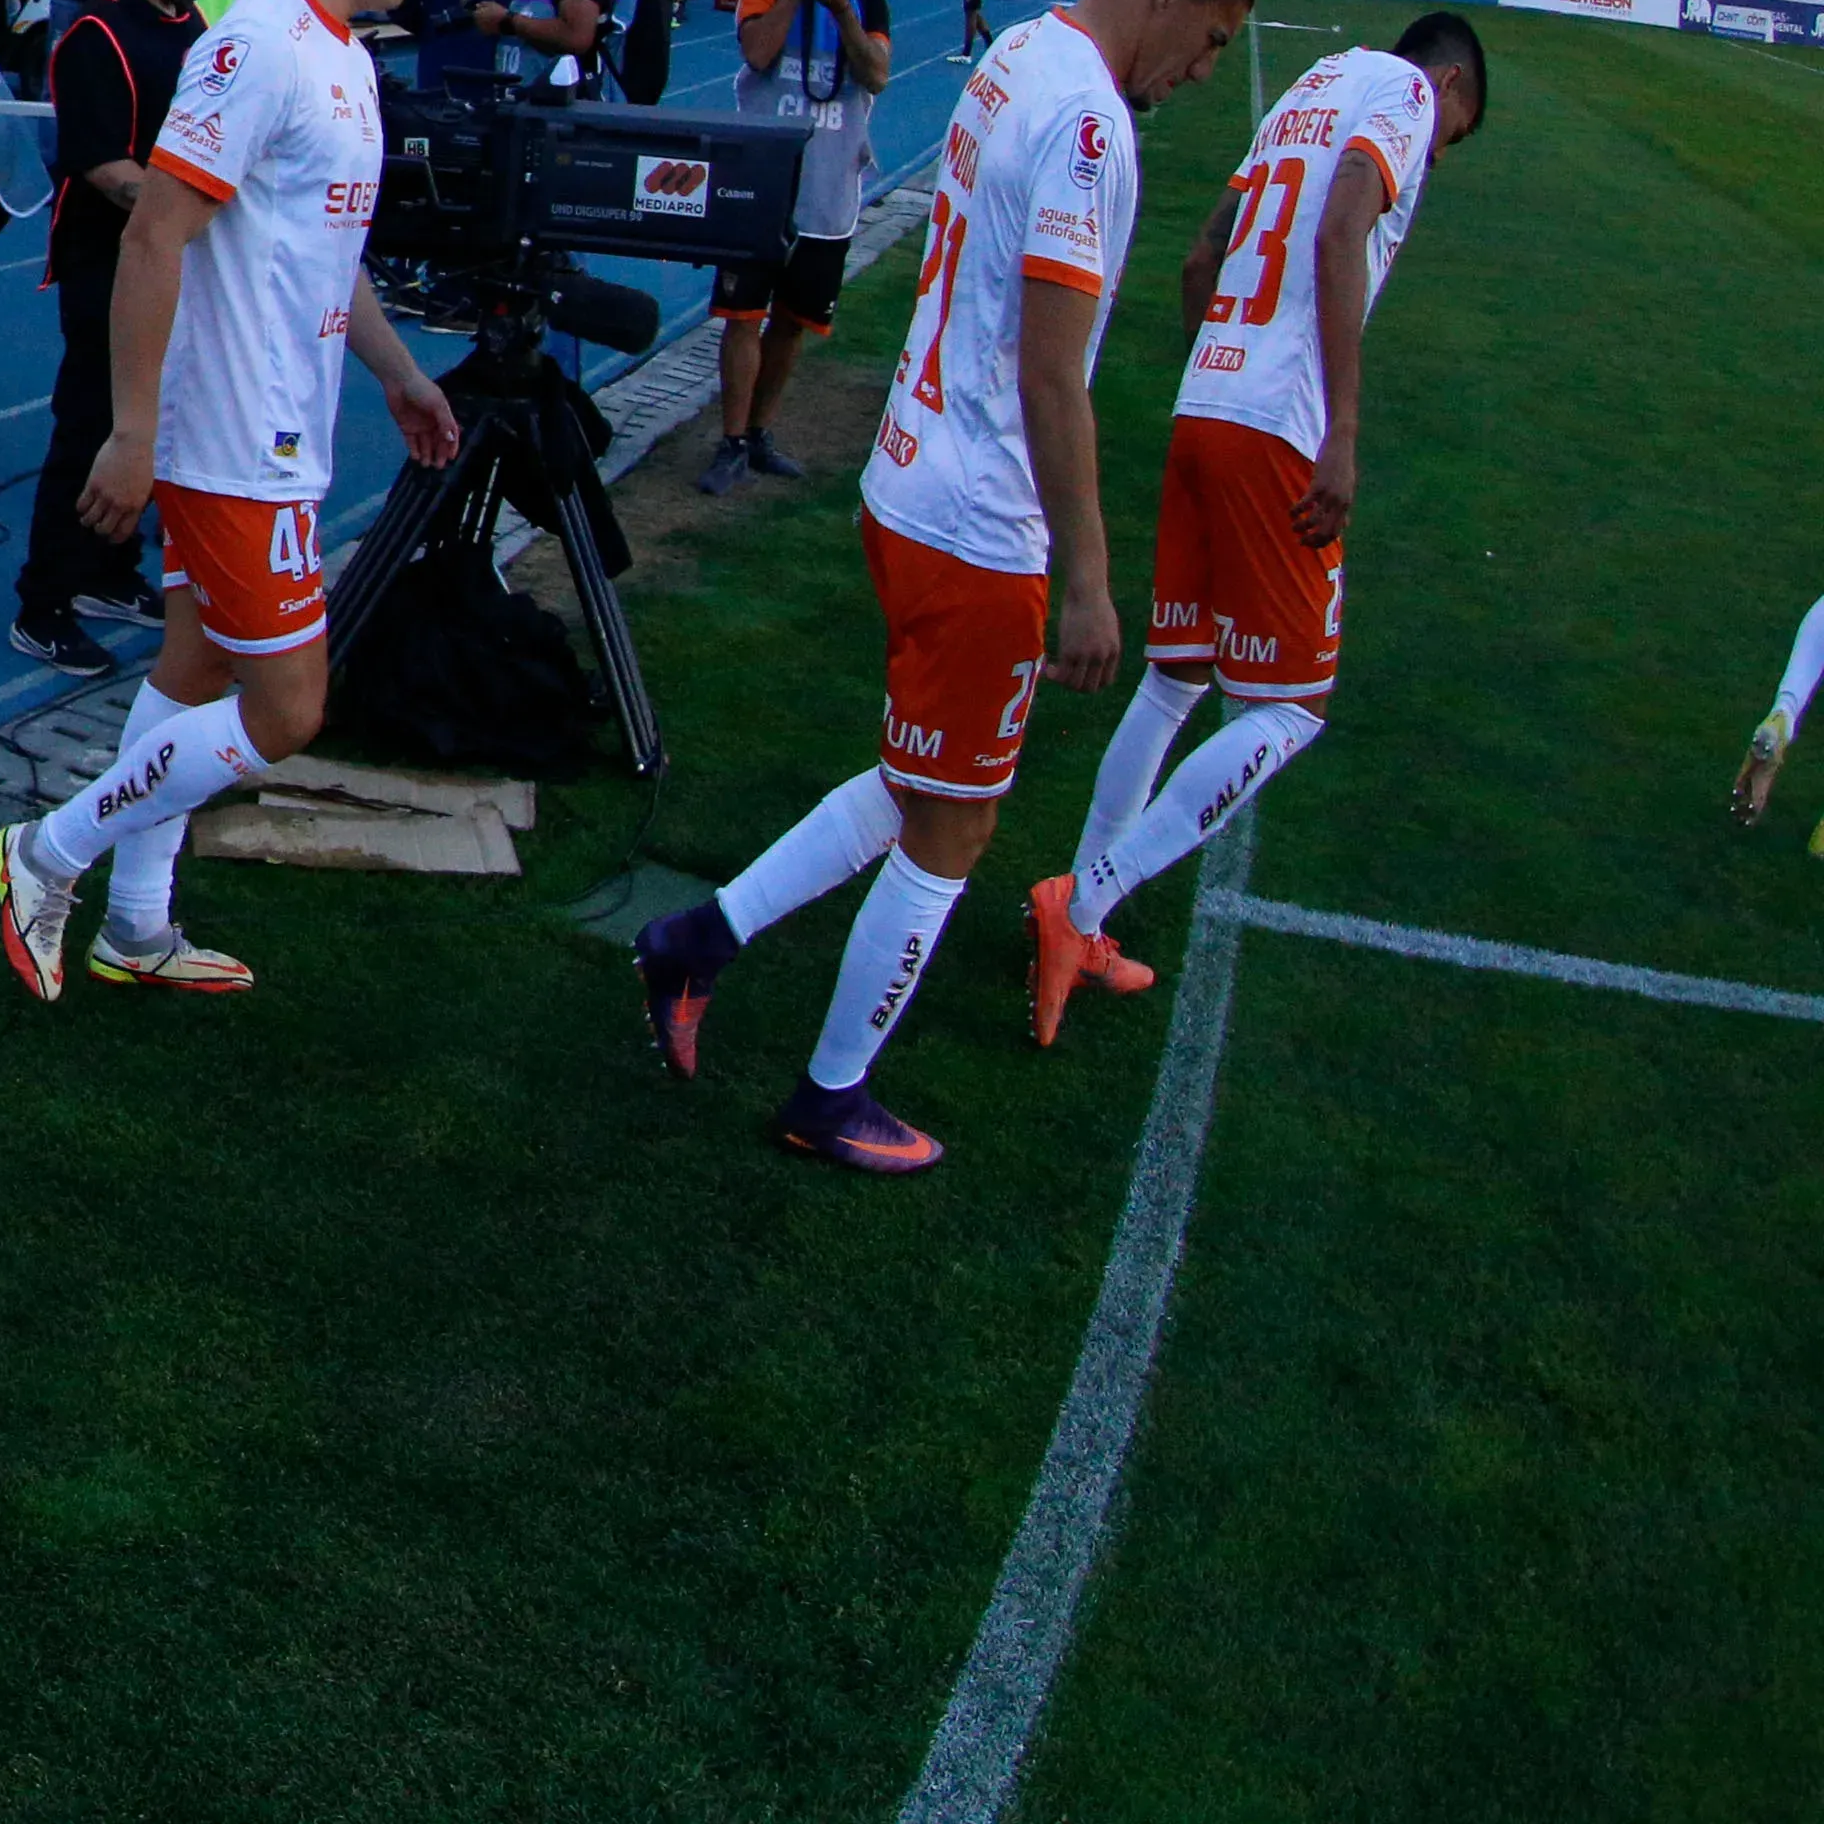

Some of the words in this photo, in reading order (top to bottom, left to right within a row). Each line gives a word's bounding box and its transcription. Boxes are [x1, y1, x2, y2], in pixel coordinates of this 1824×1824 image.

[551, 203, 573, 216] UHD
[574, 205, 626, 221] DIGISUPER
[634, 197, 704, 216] MEDIAPRO
[717, 186, 755, 200] Canon
[1038, 206, 1078, 226] aguas
[1203, 157, 1305, 326] 23
[99, 742, 174, 819] BALAP
[1199, 744, 1267, 831] BALAP
[871, 935, 921, 1029] BALAP
